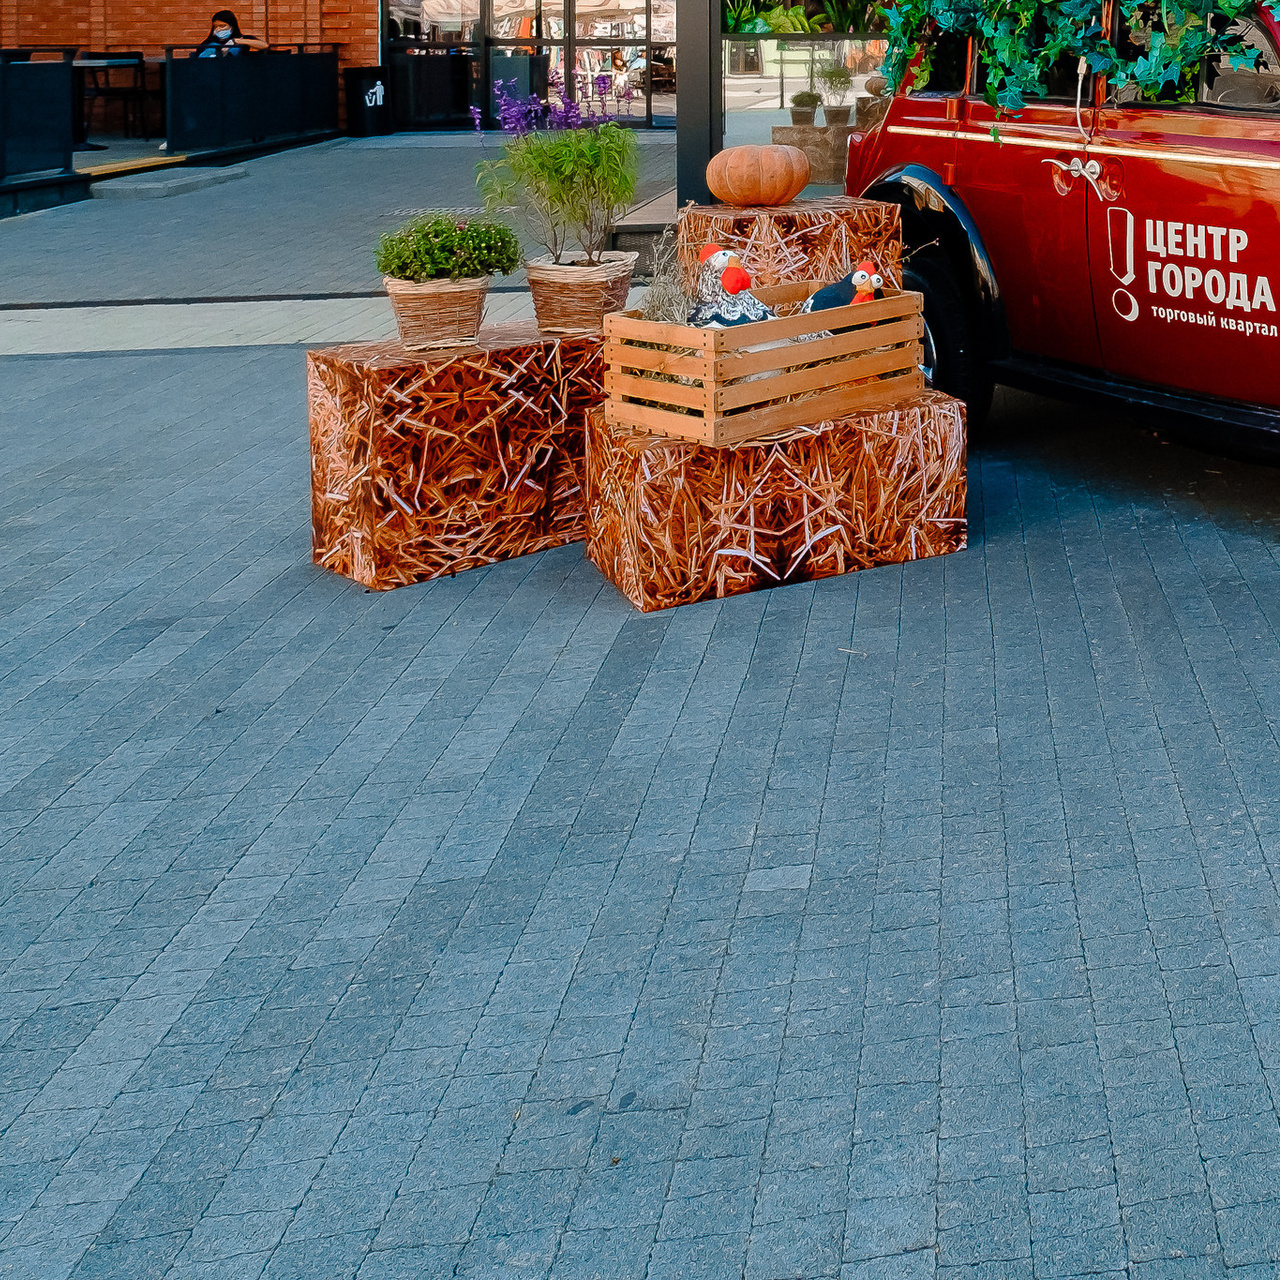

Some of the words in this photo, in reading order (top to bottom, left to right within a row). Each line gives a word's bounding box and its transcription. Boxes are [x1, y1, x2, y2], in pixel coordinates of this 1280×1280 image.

[1145, 218, 1249, 263] ЦЕНТР
[1147, 260, 1277, 312] ГОРОДА
[1151, 305, 1217, 328] торговый
[1220, 316, 1279, 338] квартал
